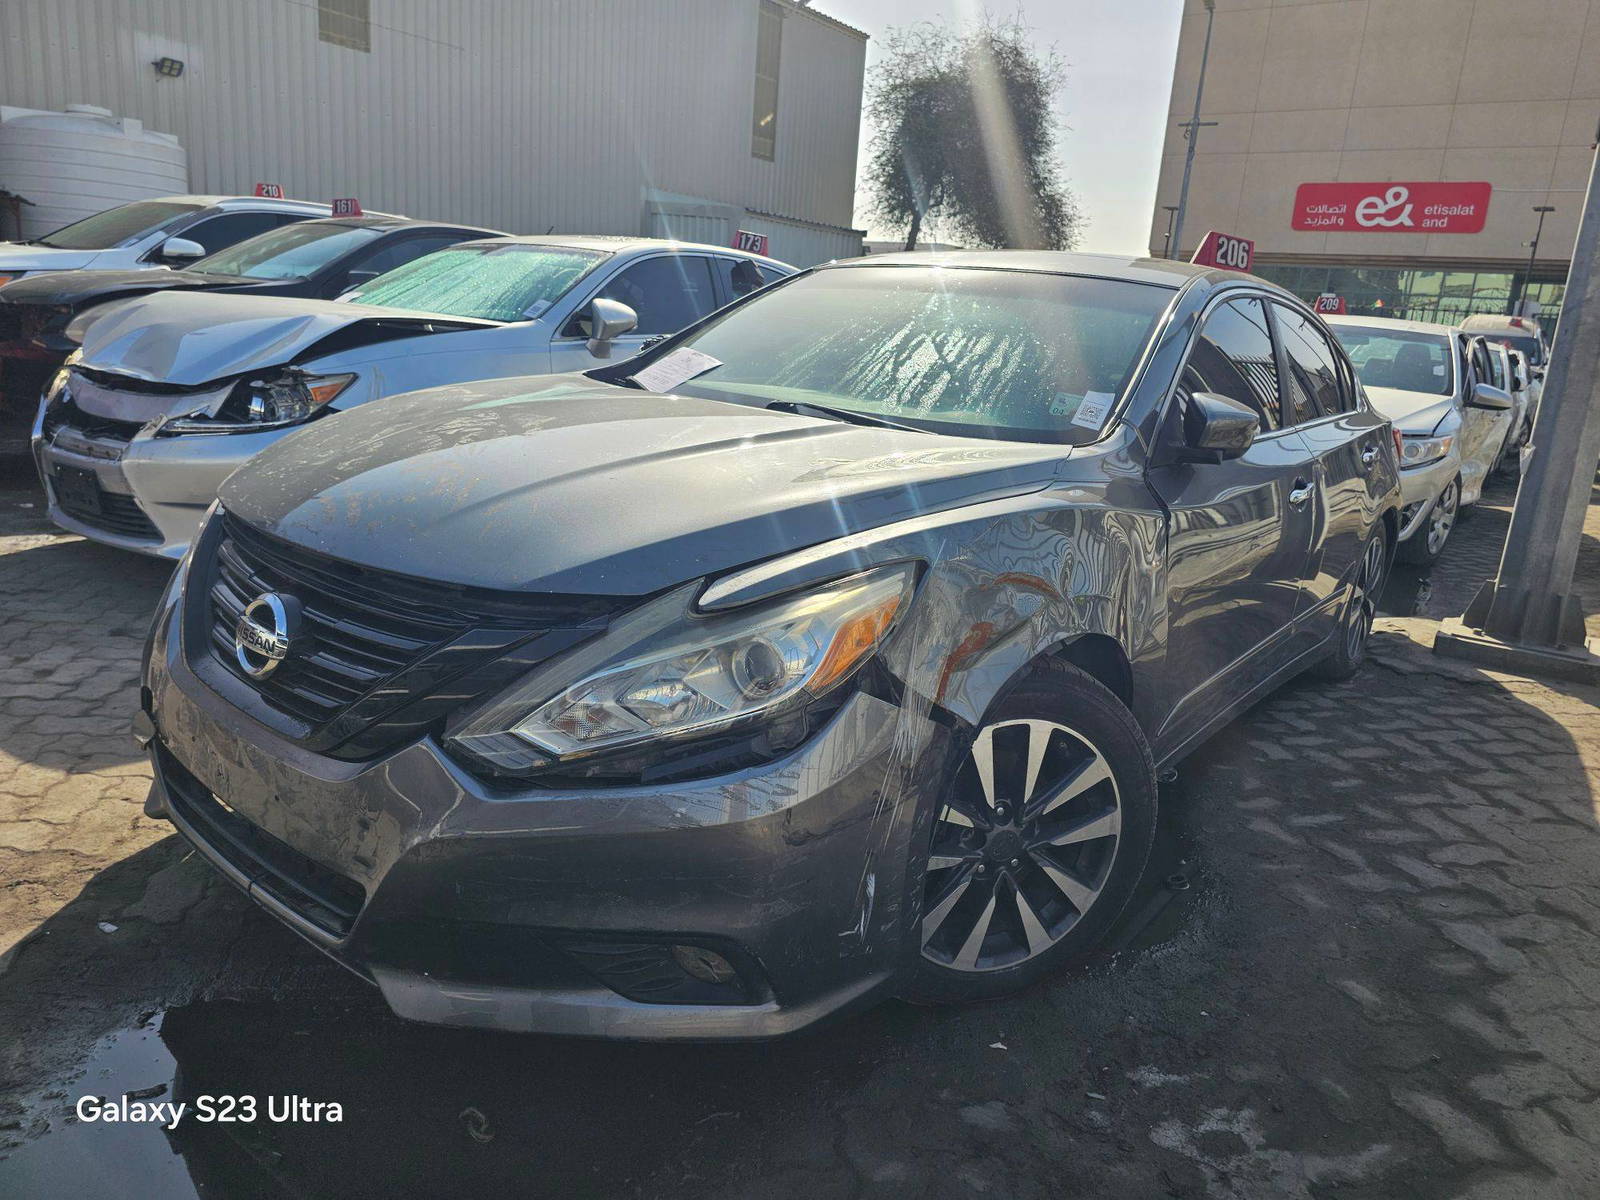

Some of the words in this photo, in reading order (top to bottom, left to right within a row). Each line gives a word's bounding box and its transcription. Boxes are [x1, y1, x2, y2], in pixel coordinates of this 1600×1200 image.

[262, 184, 279, 197] 210
[335, 200, 352, 213] 161
[1305, 203, 1347, 214] اتصالات
[1424, 204, 1475, 216] etisalat
[1422, 217, 1448, 228] and
[740, 233, 762, 252] 173
[1216, 236, 1249, 269] 206
[1319, 298, 1340, 311] 209
